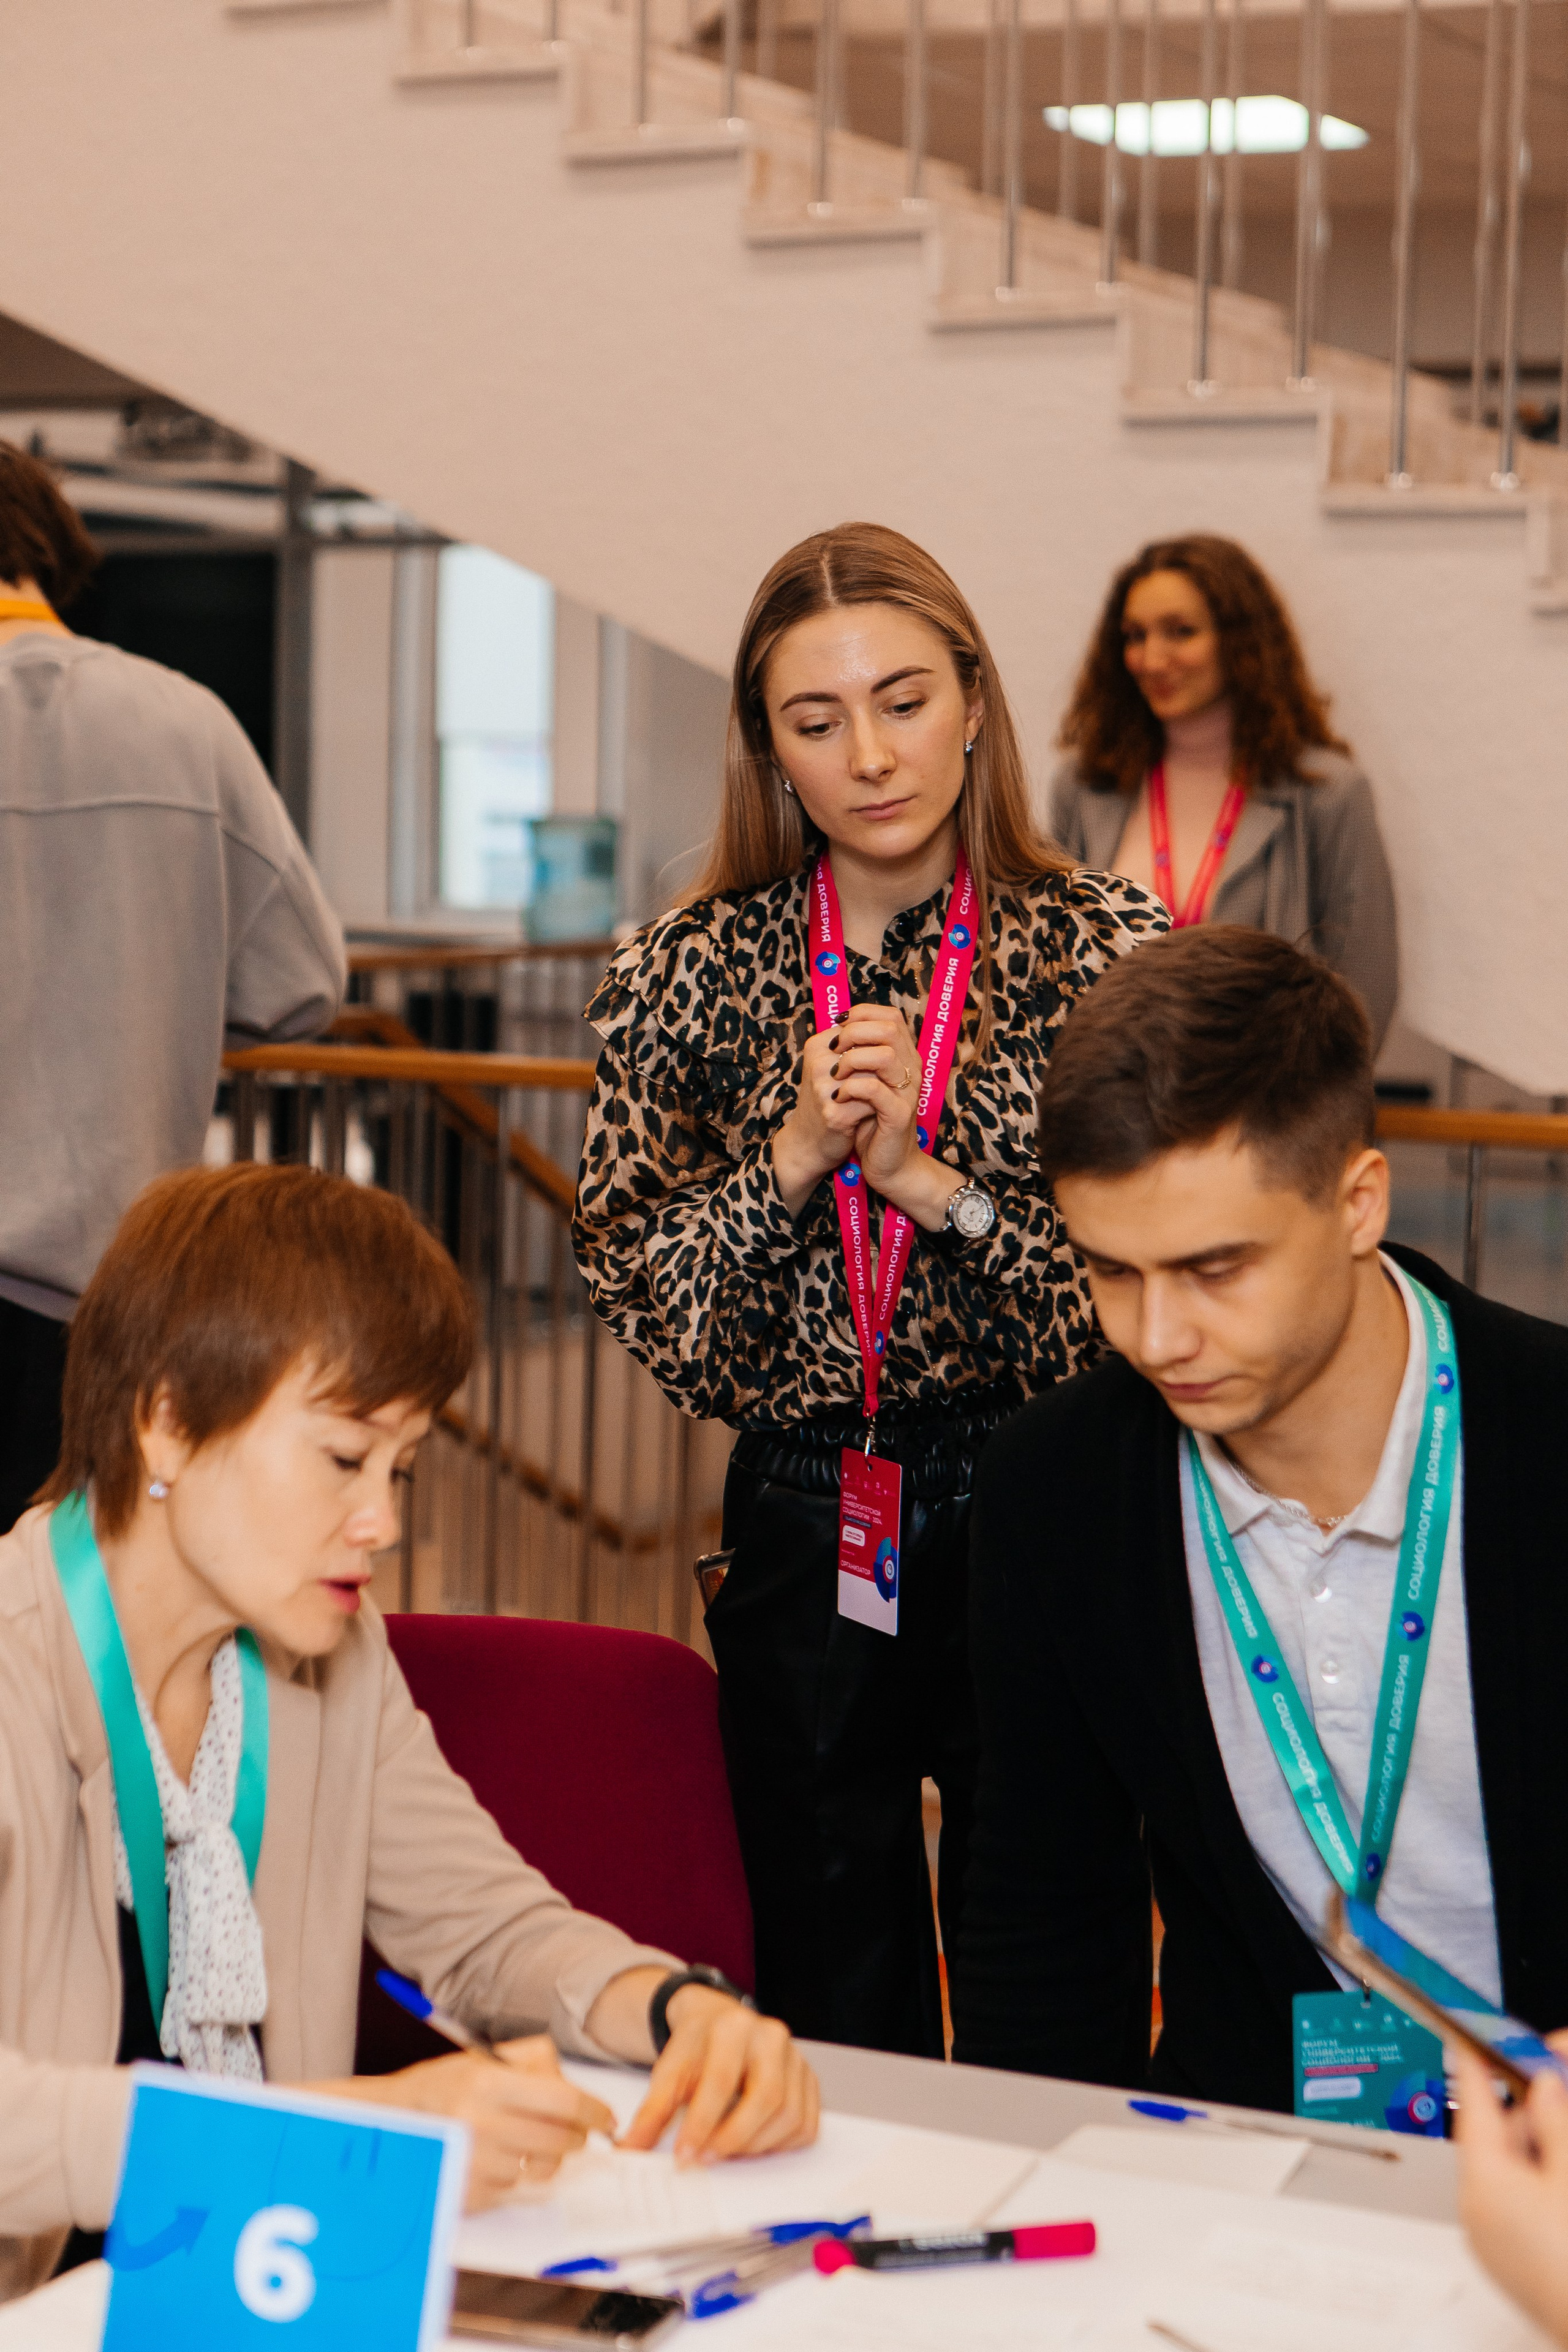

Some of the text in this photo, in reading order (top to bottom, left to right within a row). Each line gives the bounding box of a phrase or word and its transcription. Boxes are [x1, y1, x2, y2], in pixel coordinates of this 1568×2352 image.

[817, 883, 831, 942] ДОВЕРИЯ
[917, 957, 959, 1116] СОЦИОЛОГИЯ ДОВЕРИЯ
[849, 1197, 871, 1357] СОЦИОЛОГИЯ ДОВЕРИЯ
[880, 1228, 904, 1320] СОЦИОЛОГИЯ
[1408, 1406, 1444, 1600] СОЦИОЛОГИЯ ДОВЕРИЯ
[1221, 1566, 1258, 1639] ДОВЕРИЯ
[1390, 1654, 1409, 1730] ДОВЕРИЯ
[1272, 1692, 1354, 1874] СОЦИОЛОГИЯ ДОВЕРИЯ
[233, 2204, 319, 2324] 6
